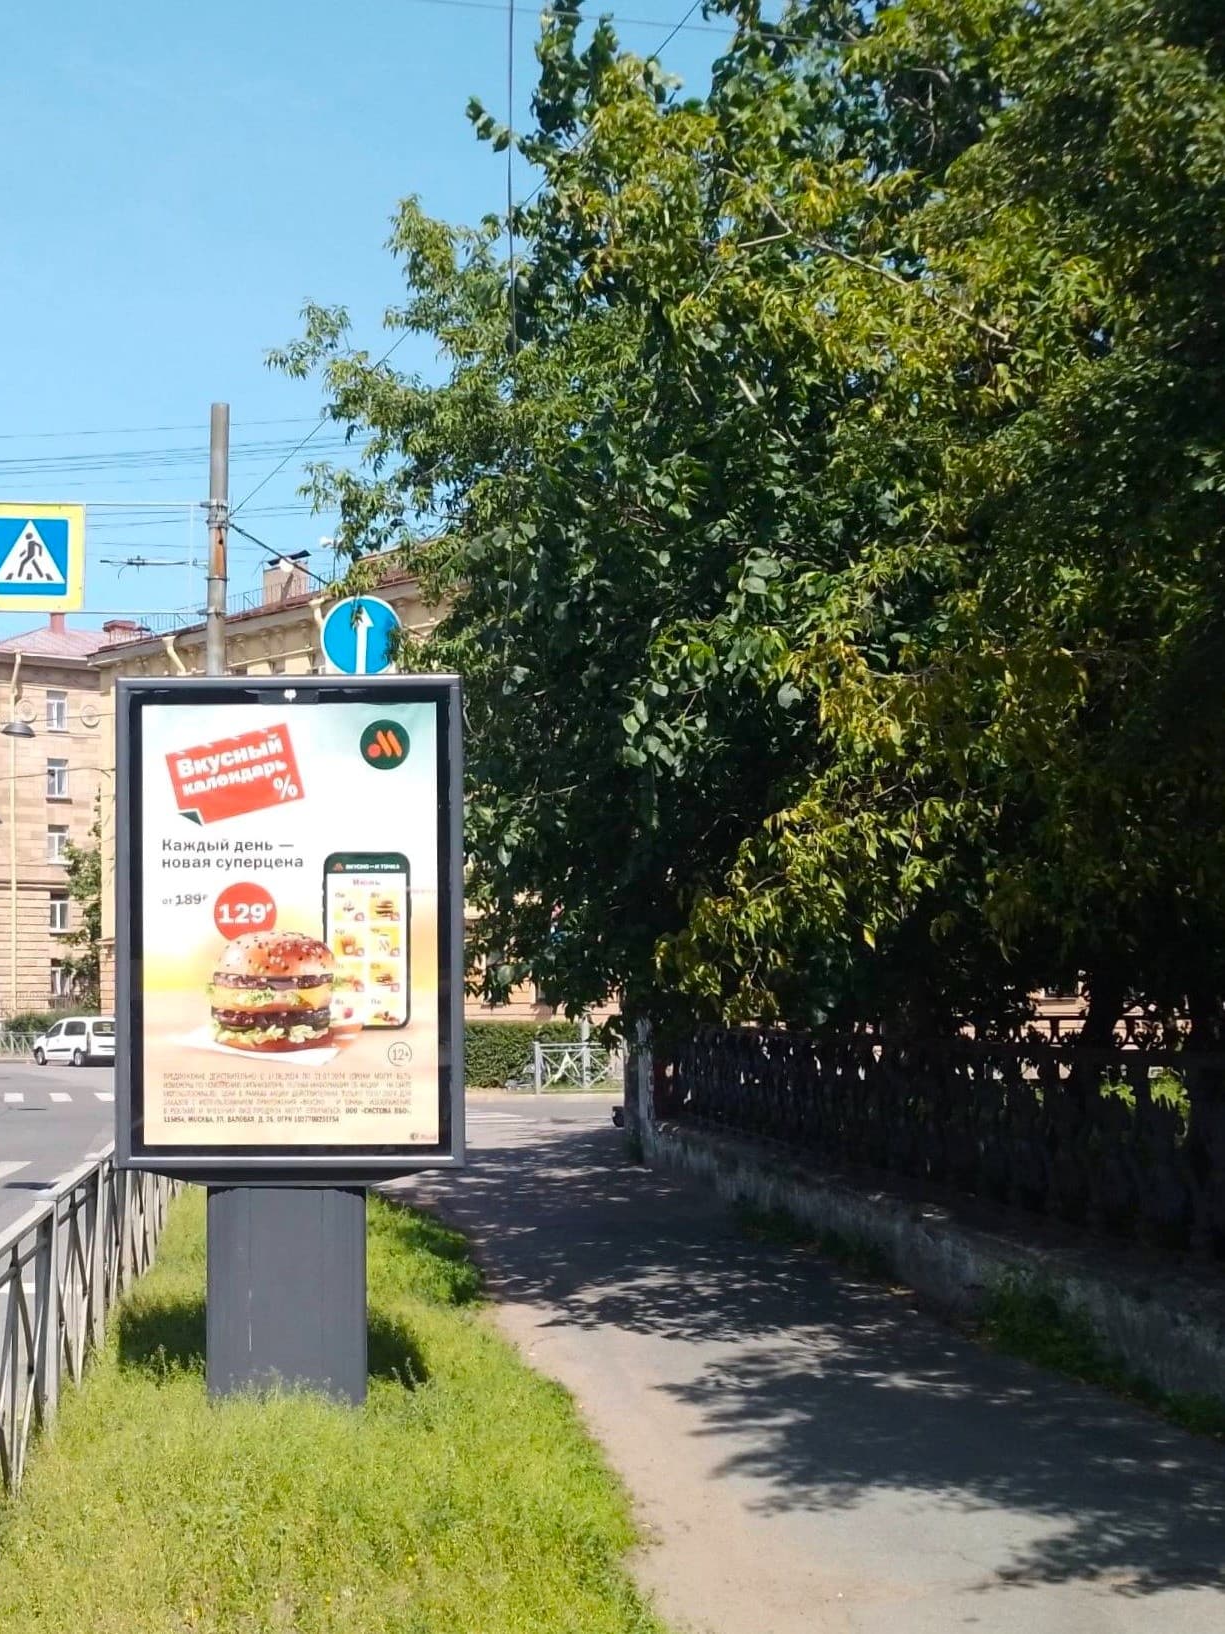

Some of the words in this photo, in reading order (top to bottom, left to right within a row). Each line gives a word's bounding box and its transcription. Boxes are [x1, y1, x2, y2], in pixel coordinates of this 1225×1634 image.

[176, 733, 284, 779] Вкусный
[182, 760, 287, 796] календарь
[162, 838, 229, 853] Каждый
[234, 841, 273, 853] день
[162, 858, 211, 868] новая
[216, 858, 304, 871] суперцена
